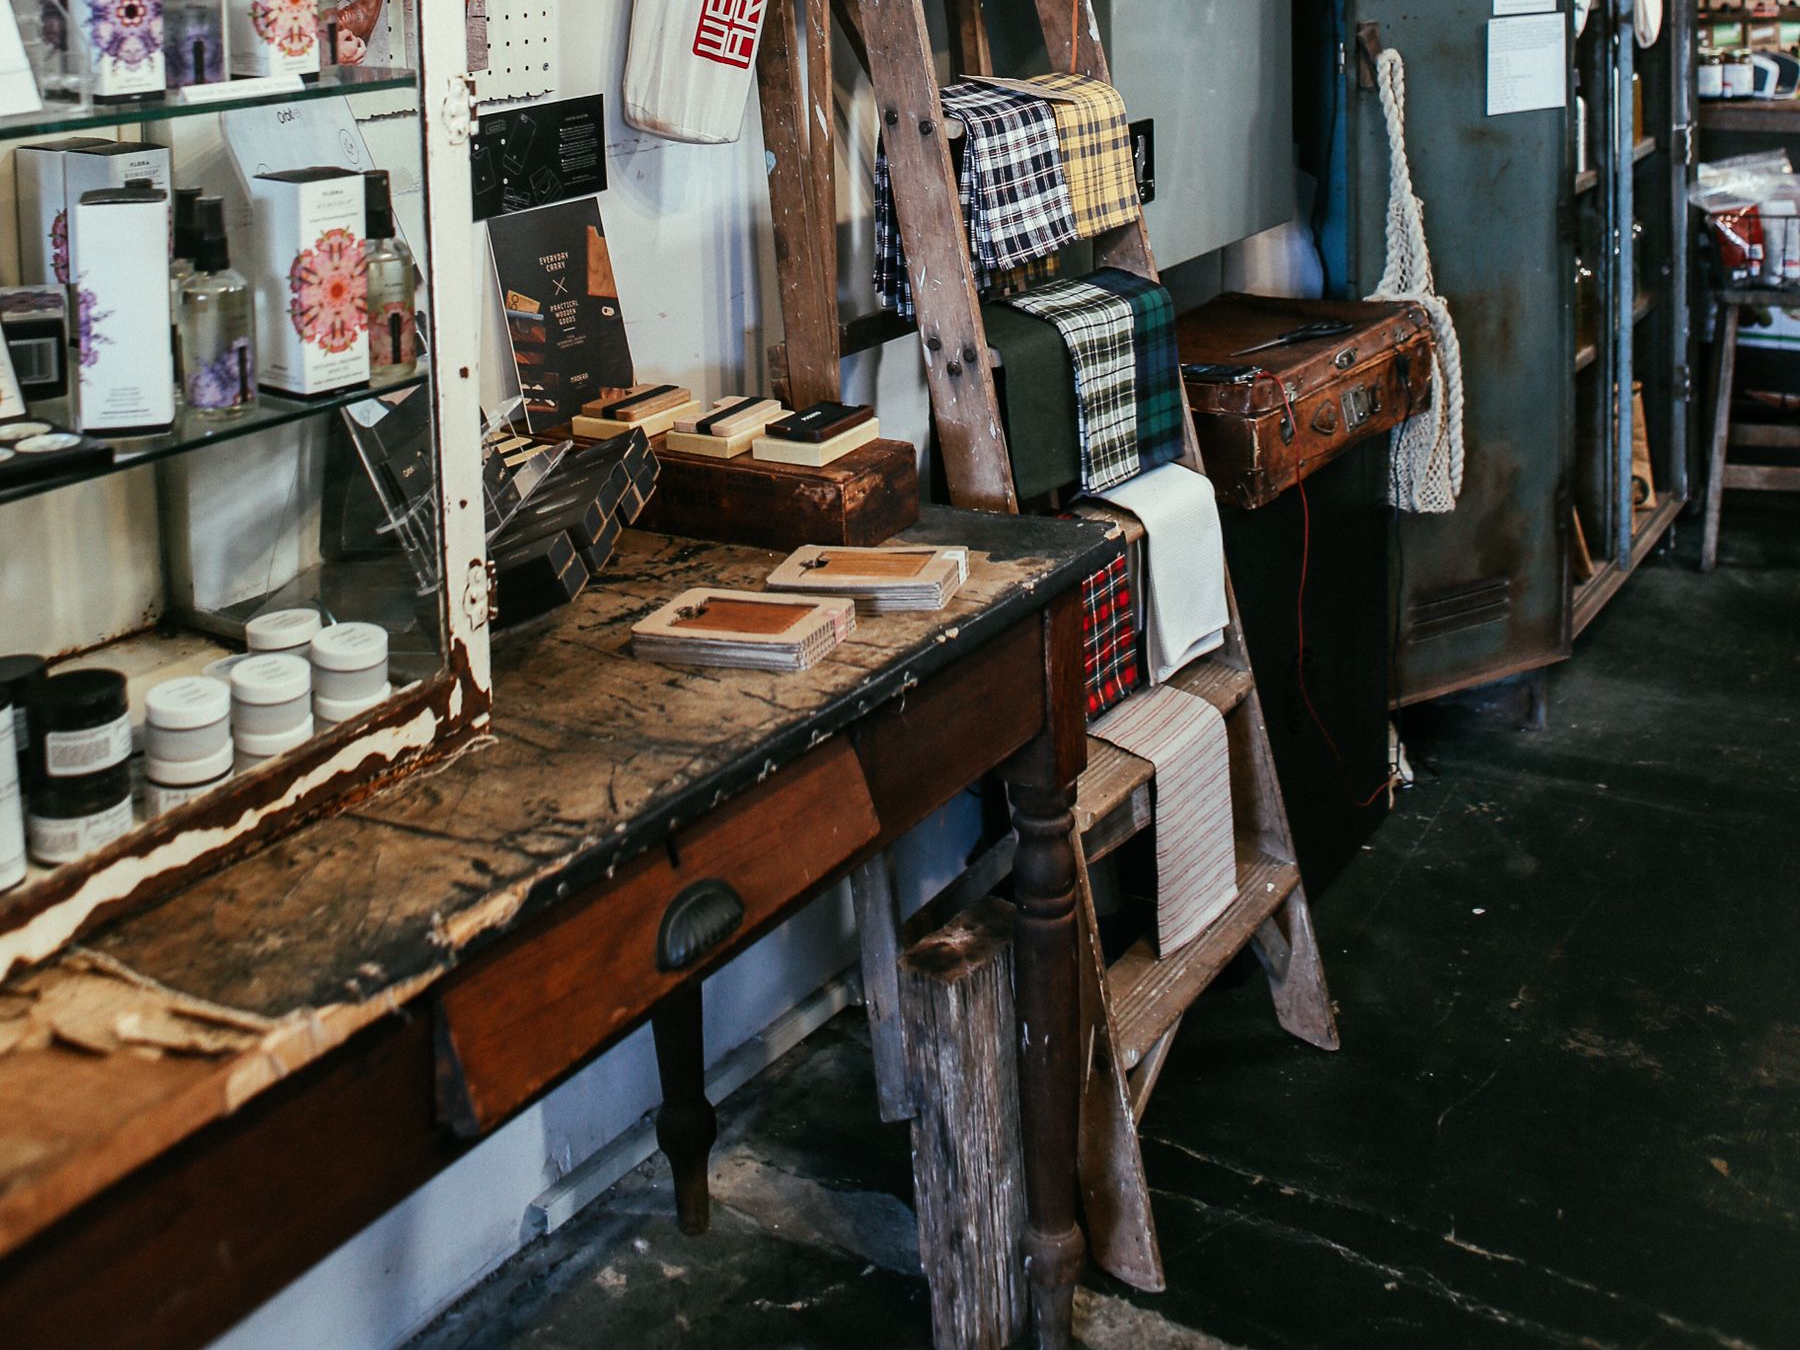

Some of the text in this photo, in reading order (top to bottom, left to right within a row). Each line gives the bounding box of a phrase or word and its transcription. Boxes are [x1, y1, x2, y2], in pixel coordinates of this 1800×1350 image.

[538, 252, 569, 266] EVERYDAY
[546, 261, 566, 273] CARRY
[549, 299, 579, 312] PRACTICAL
[555, 308, 577, 318] WOODEN
[559, 315, 577, 325] GOODS
